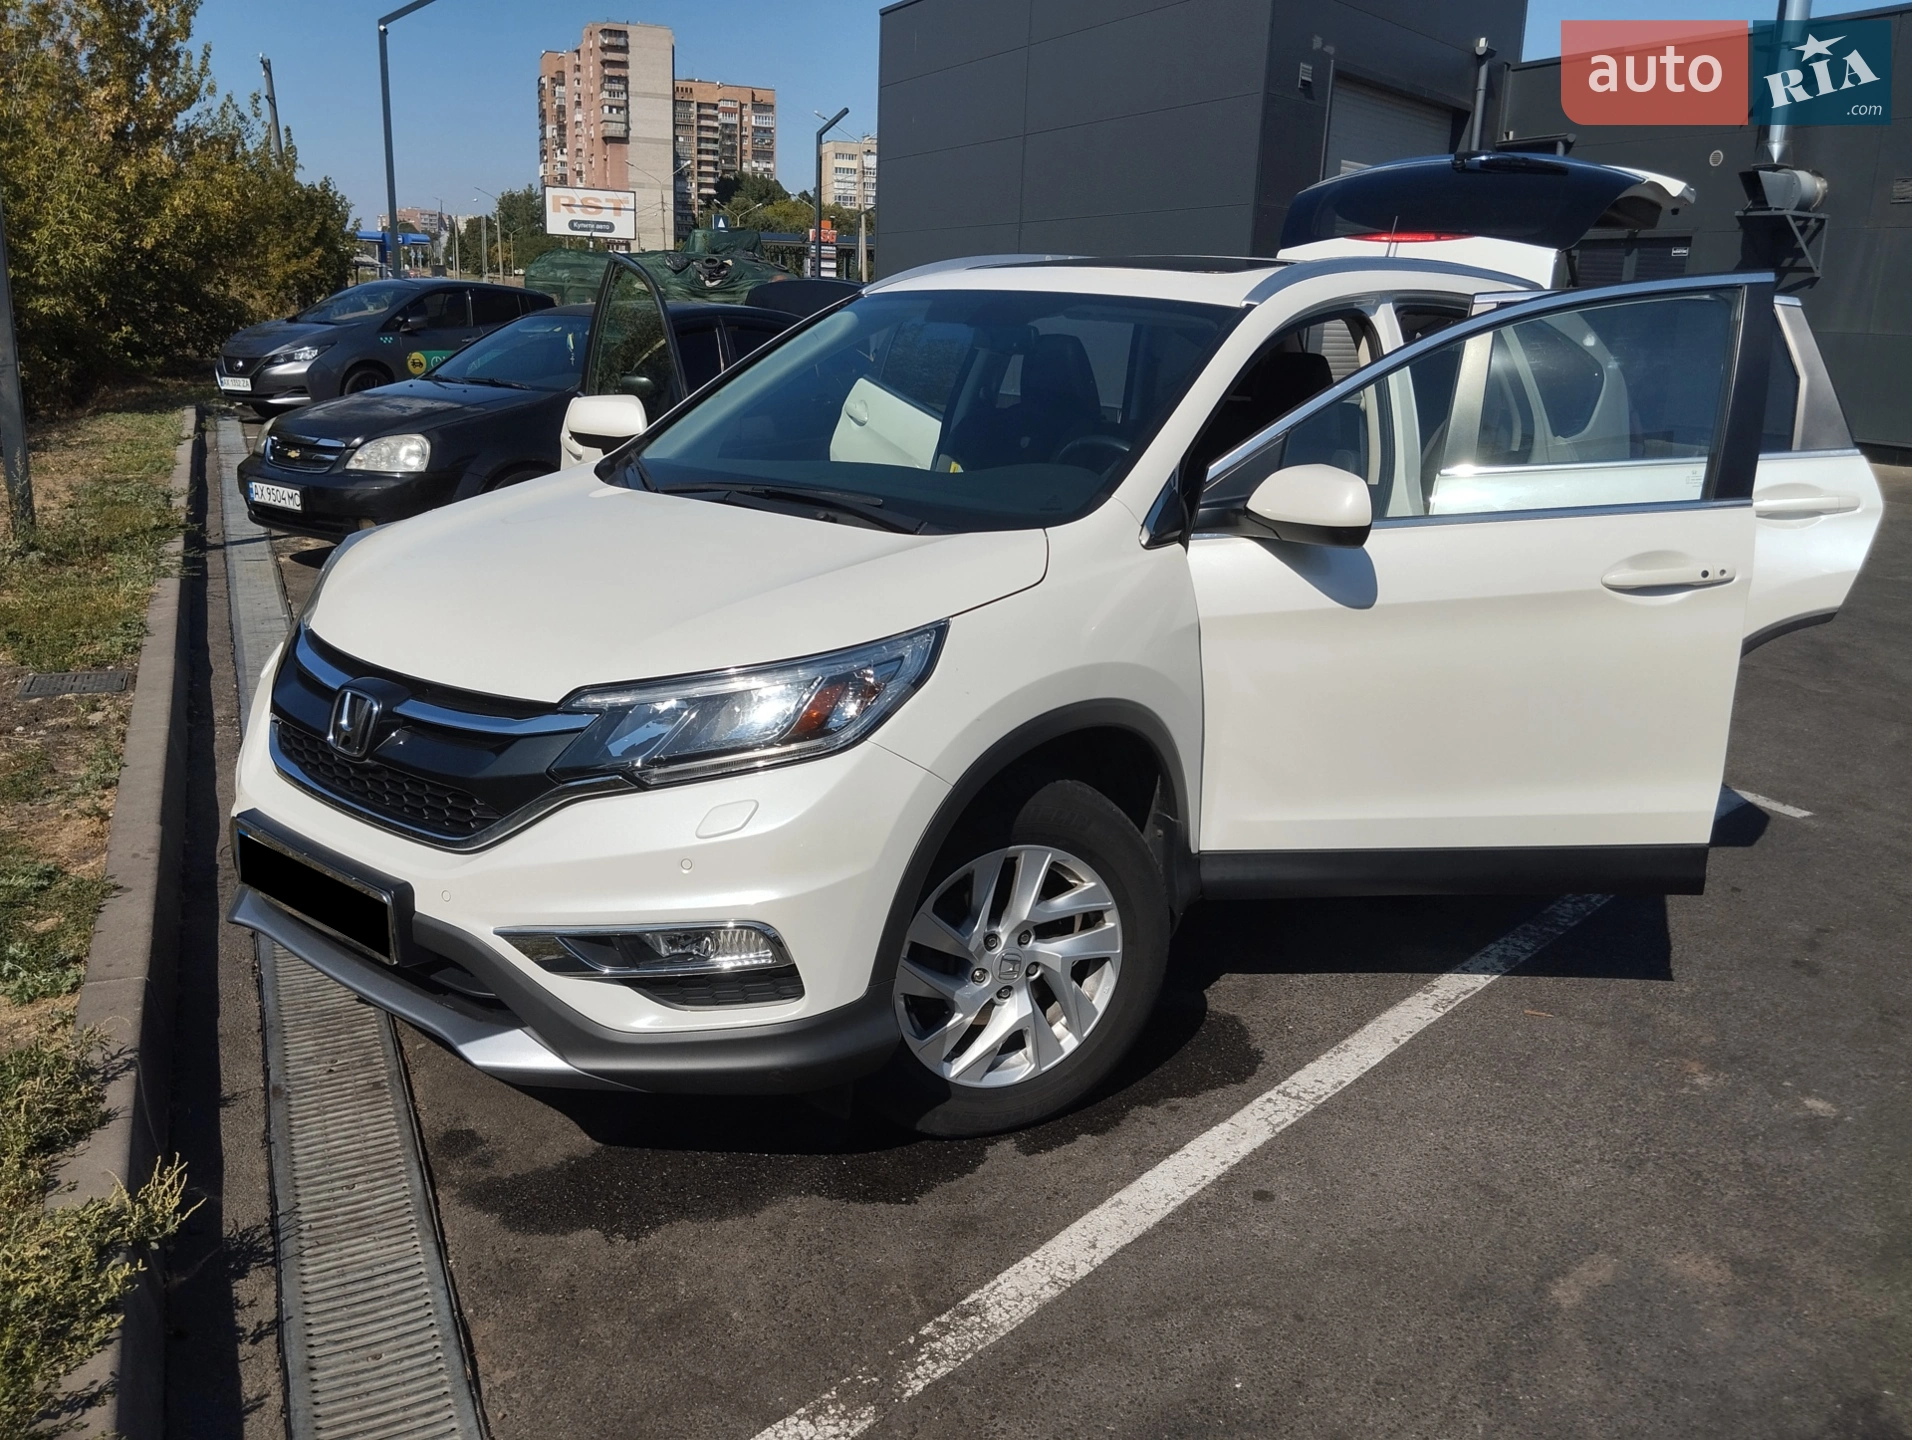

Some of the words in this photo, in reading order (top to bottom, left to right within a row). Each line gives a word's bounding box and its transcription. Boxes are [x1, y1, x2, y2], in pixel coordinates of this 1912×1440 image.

[552, 195, 629, 217] RST
[573, 221, 595, 230] Купити
[254, 484, 266, 499] AX
[266, 487, 287, 504] 9504
